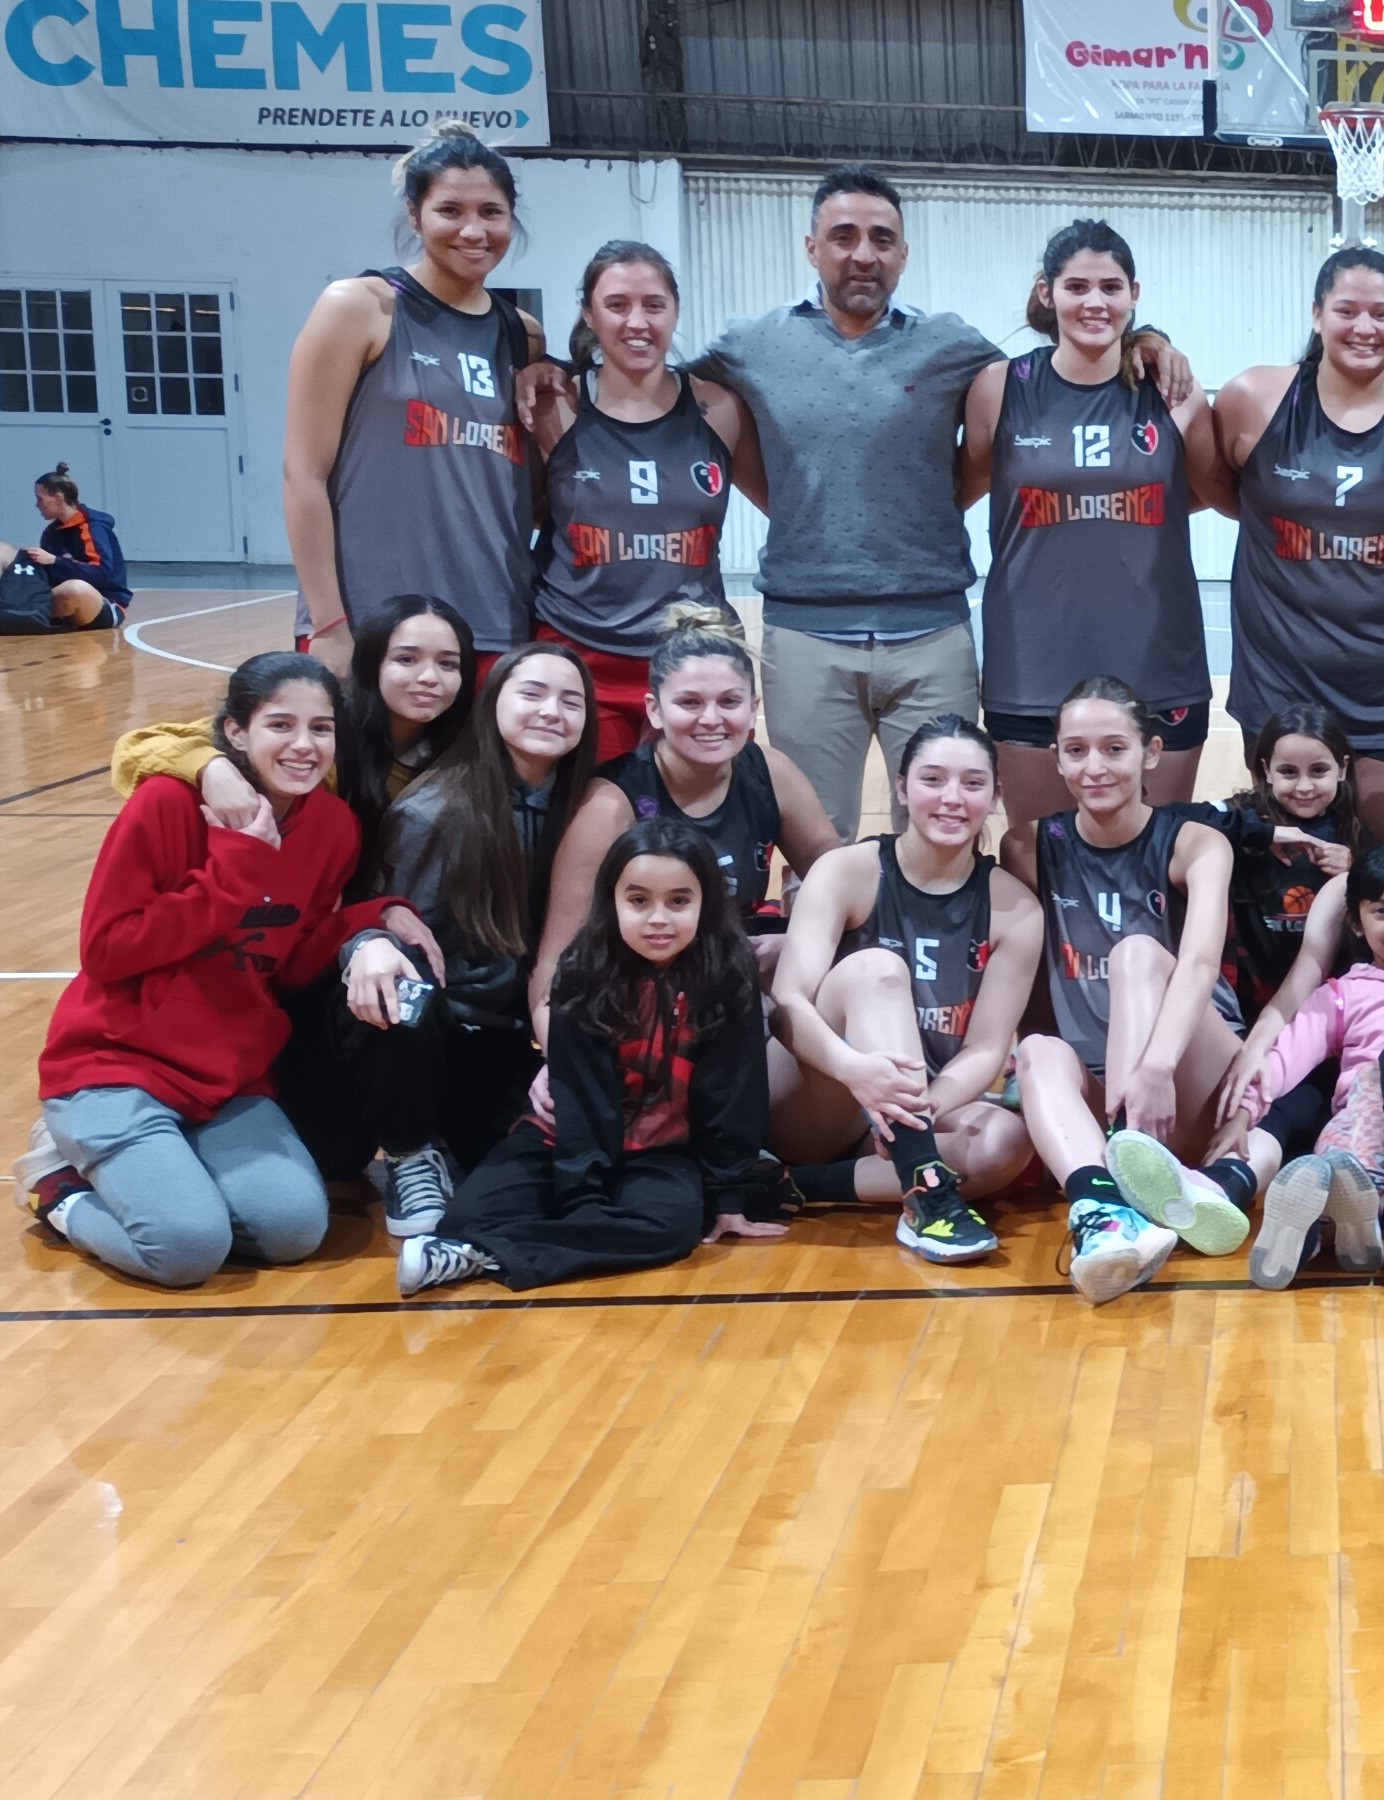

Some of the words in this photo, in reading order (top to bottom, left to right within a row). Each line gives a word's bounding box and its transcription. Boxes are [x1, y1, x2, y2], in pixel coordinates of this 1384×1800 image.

[5, 0, 533, 95] CHEMES
[258, 107, 376, 127] PRENDETE
[380, 109, 394, 127] A
[400, 109, 429, 128] LO
[458, 352, 495, 398] 13
[404, 399, 449, 447] SAN
[1072, 425, 1111, 467] 12
[630, 460, 659, 504] 9
[1335, 465, 1364, 507] 7
[1018, 486, 1061, 528] SAN
[1066, 482, 1166, 527] LORENZO
[1098, 892, 1122, 932] 4
[915, 937, 940, 981] 5
